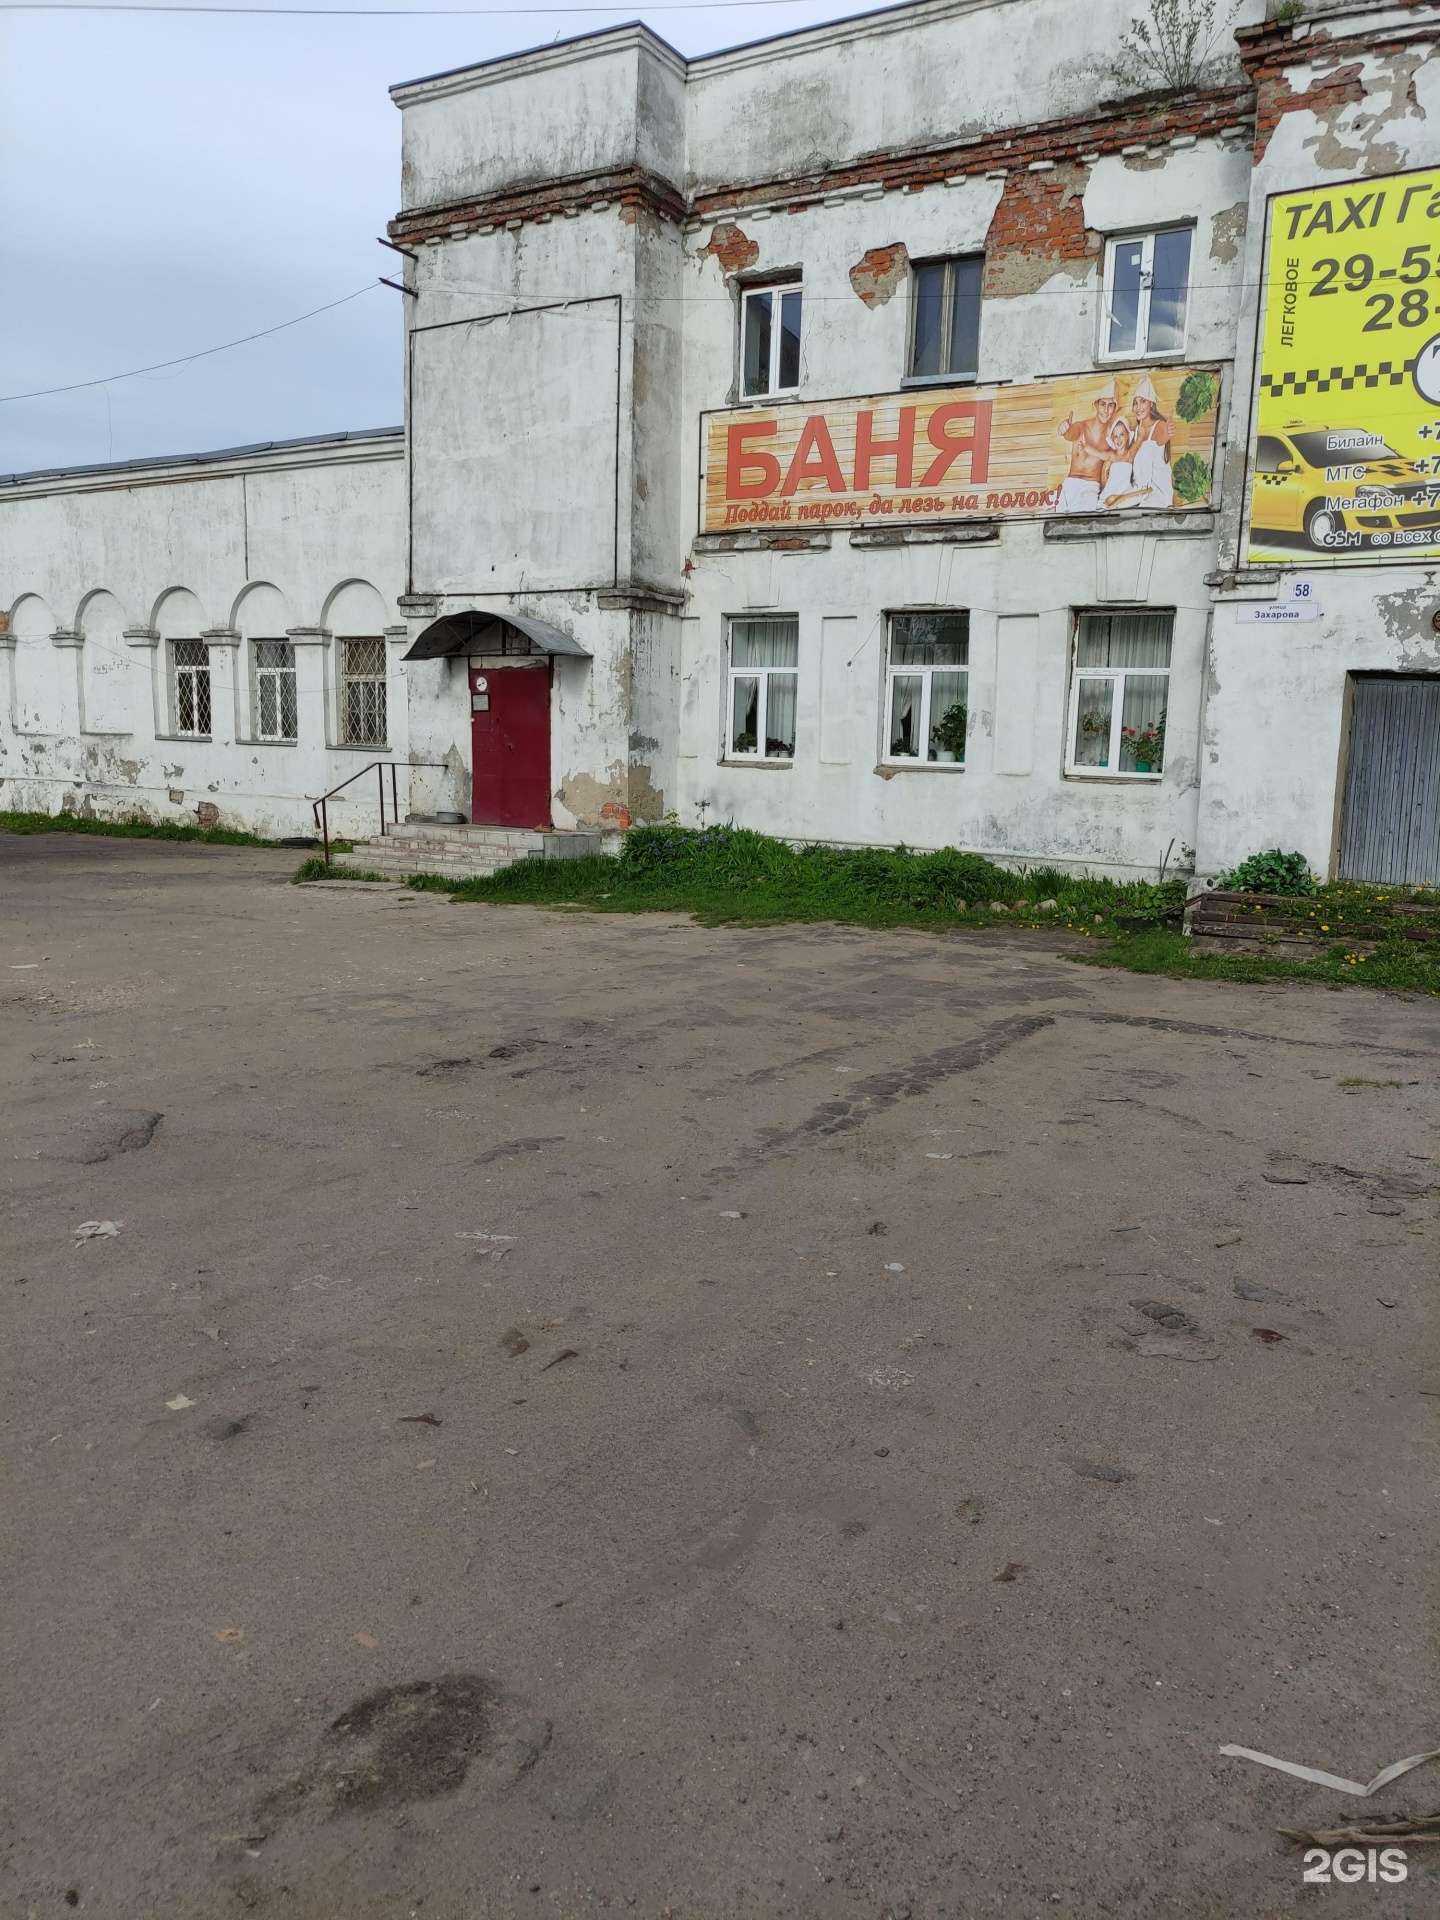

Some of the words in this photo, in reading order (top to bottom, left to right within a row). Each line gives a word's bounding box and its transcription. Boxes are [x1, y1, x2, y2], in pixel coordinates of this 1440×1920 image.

[1308, 244, 1440, 298] 29-5
[1281, 257, 1299, 347] ЛЕГКОВОЕ
[1361, 288, 1440, 333] 28
[726, 401, 992, 499] БАНЯ
[1327, 435, 1382, 449] Билайн
[1326, 466, 1365, 482] МТС
[724, 500, 792, 524] Поддай
[799, 501, 862, 523] парок,
[868, 493, 893, 515] да
[898, 496, 945, 514] лезь
[951, 494, 979, 511] на
[985, 484, 1063, 510] полок!
[1326, 496, 1403, 511] Мегафон
[1413, 490, 1440, 508] +7
[1324, 531, 1360, 546] GSM
[1371, 533, 1390, 545] со
[1395, 530, 1430, 543] всех
[1295, 584, 1310, 597] 58
[1254, 611, 1299, 619] Захарова
